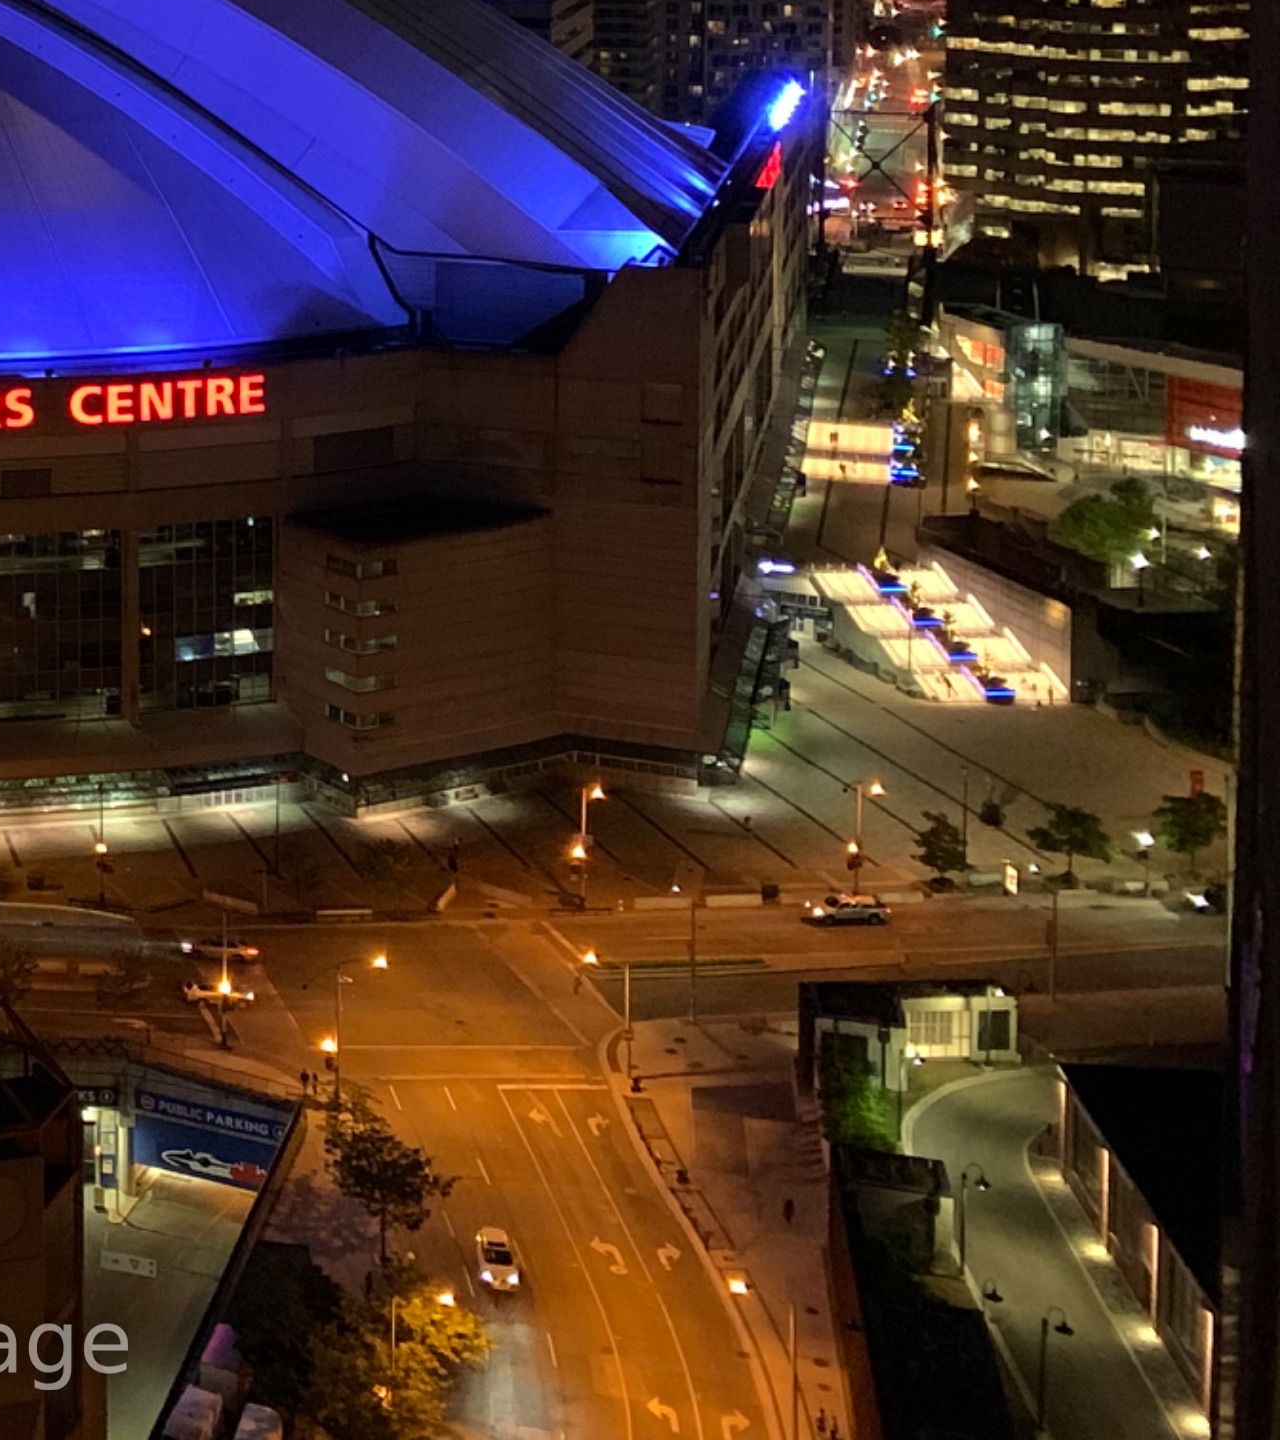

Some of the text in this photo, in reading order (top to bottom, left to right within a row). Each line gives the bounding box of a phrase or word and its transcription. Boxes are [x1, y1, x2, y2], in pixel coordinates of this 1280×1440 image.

[68, 374, 265, 426] CENTRE
[157, 1098, 270, 1136] PUBLIC PARKING
